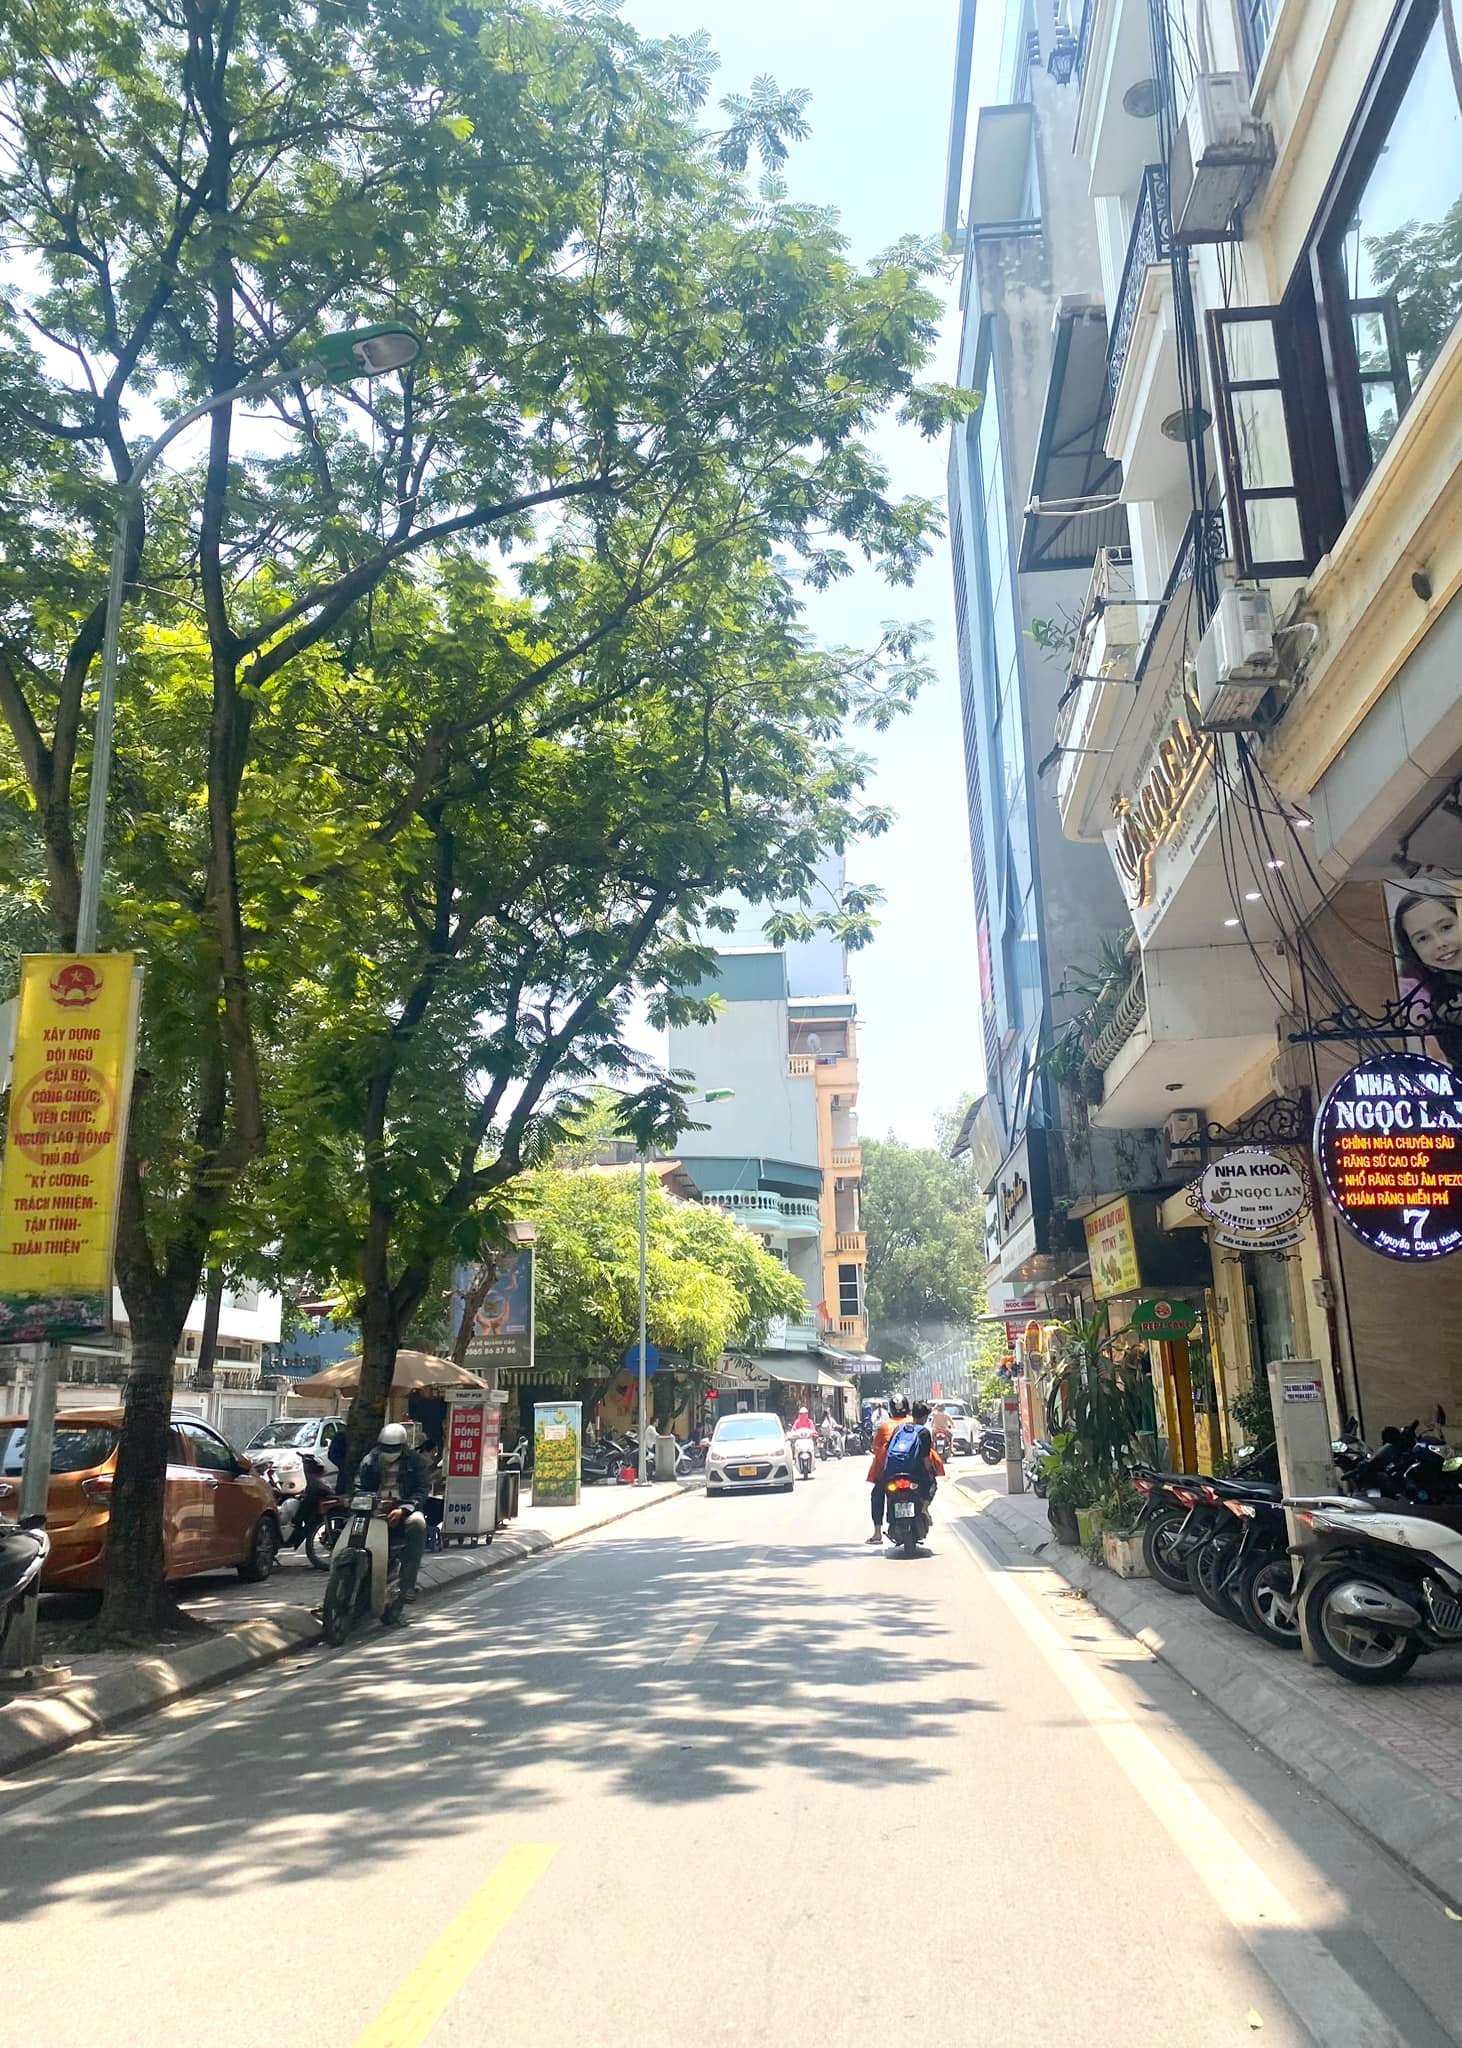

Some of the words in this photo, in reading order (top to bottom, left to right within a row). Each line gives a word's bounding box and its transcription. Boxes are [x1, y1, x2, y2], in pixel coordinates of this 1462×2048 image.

[68, 1028, 101, 1043] DỰNG
[46, 1047, 65, 1064] ĐỘI
[69, 1047, 94, 1061] NGŨ
[1355, 1074, 1396, 1096] NHA
[32, 1090, 62, 1103] CÔNG
[65, 1087, 102, 1104] CHỨC,
[61, 1109, 96, 1124] CHỨC,
[1334, 1101, 1413, 1135] NGỌC
[52, 1131, 74, 1144] LAO
[77, 1129, 112, 1146] ĐỘNG
[1342, 1134, 1371, 1149] CHỈNH
[1373, 1137, 1393, 1149] NHA
[1395, 1135, 1433, 1149] CHUYÊN
[1435, 1134, 1455, 1149] SÂU
[1343, 1154, 1371, 1167] RĂNG
[1372, 1153, 1386, 1167] SỨ
[1388, 1156, 1408, 1167] CAO
[1410, 1152, 1429, 1167] CẤP
[1215, 1165, 1247, 1177] NHA
[1250, 1164, 1290, 1176] KHOA
[1367, 1173, 1395, 1186] RĂNG
[1397, 1171, 1419, 1186] SIÊU
[1421, 1171, 1436, 1186] ÂM
[1234, 1187, 1272, 1199] NGỌC
[1275, 1186, 1301, 1197] LAN
[1346, 1191, 1375, 1205] KHÁM
[1377, 1192, 1405, 1205] RĂNG
[1406, 1189, 1431, 1205] MIỄN
[1432, 1190, 1449, 1205] PHÍ
[14, 1195, 50, 1211] TRÁCH
[1219, 1209, 1254, 1225] COSMETIC
[1257, 1208, 1294, 1225] DENTISTRY
[1403, 1209, 1430, 1239] 7
[25, 1216, 46, 1234] TẬN
[12, 1239, 42, 1255] THÂN
[1377, 1231, 1410, 1250] Nguyễn
[1414, 1241, 1438, 1251] Công
[455, 1451, 476, 1460] THAY
[456, 1463, 473, 1473] PIN
